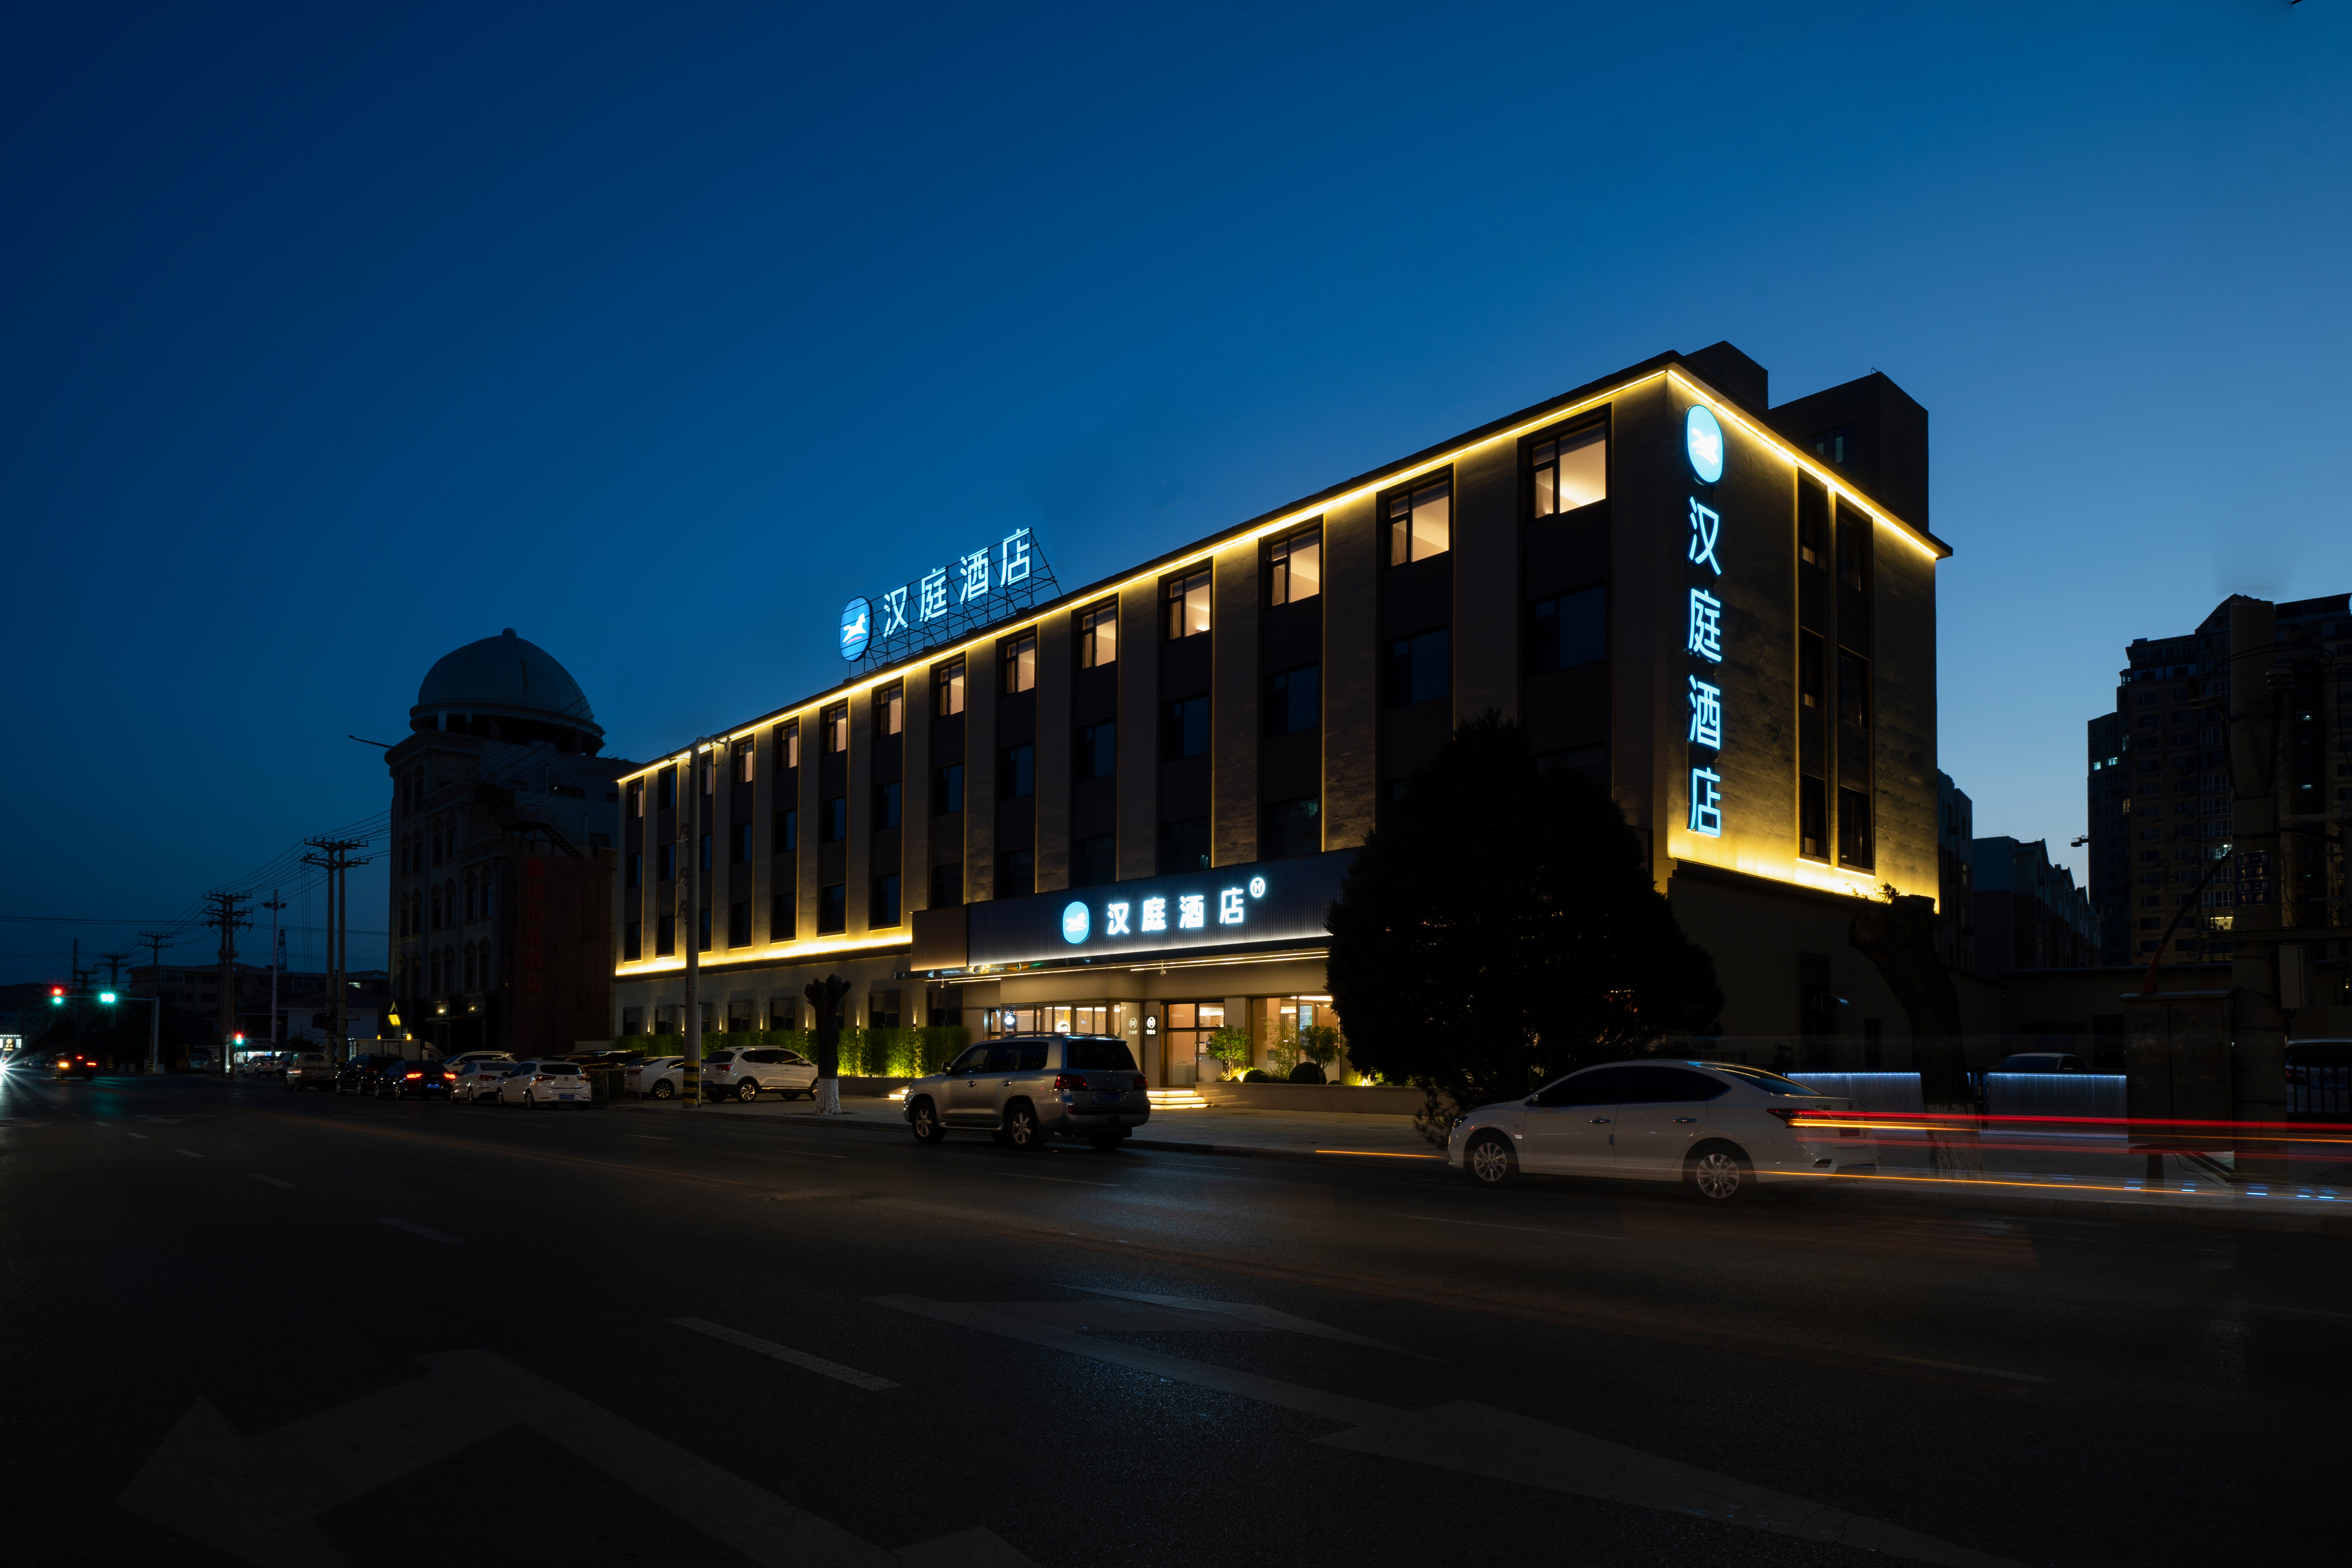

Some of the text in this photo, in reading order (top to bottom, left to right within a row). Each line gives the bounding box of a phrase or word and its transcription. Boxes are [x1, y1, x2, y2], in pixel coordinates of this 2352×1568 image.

[884, 528, 1031, 638] 汉庭酒店
[1688, 497, 1721, 837] 汉庭酒店
[1107, 887, 1244, 935] 汉庭酒店
